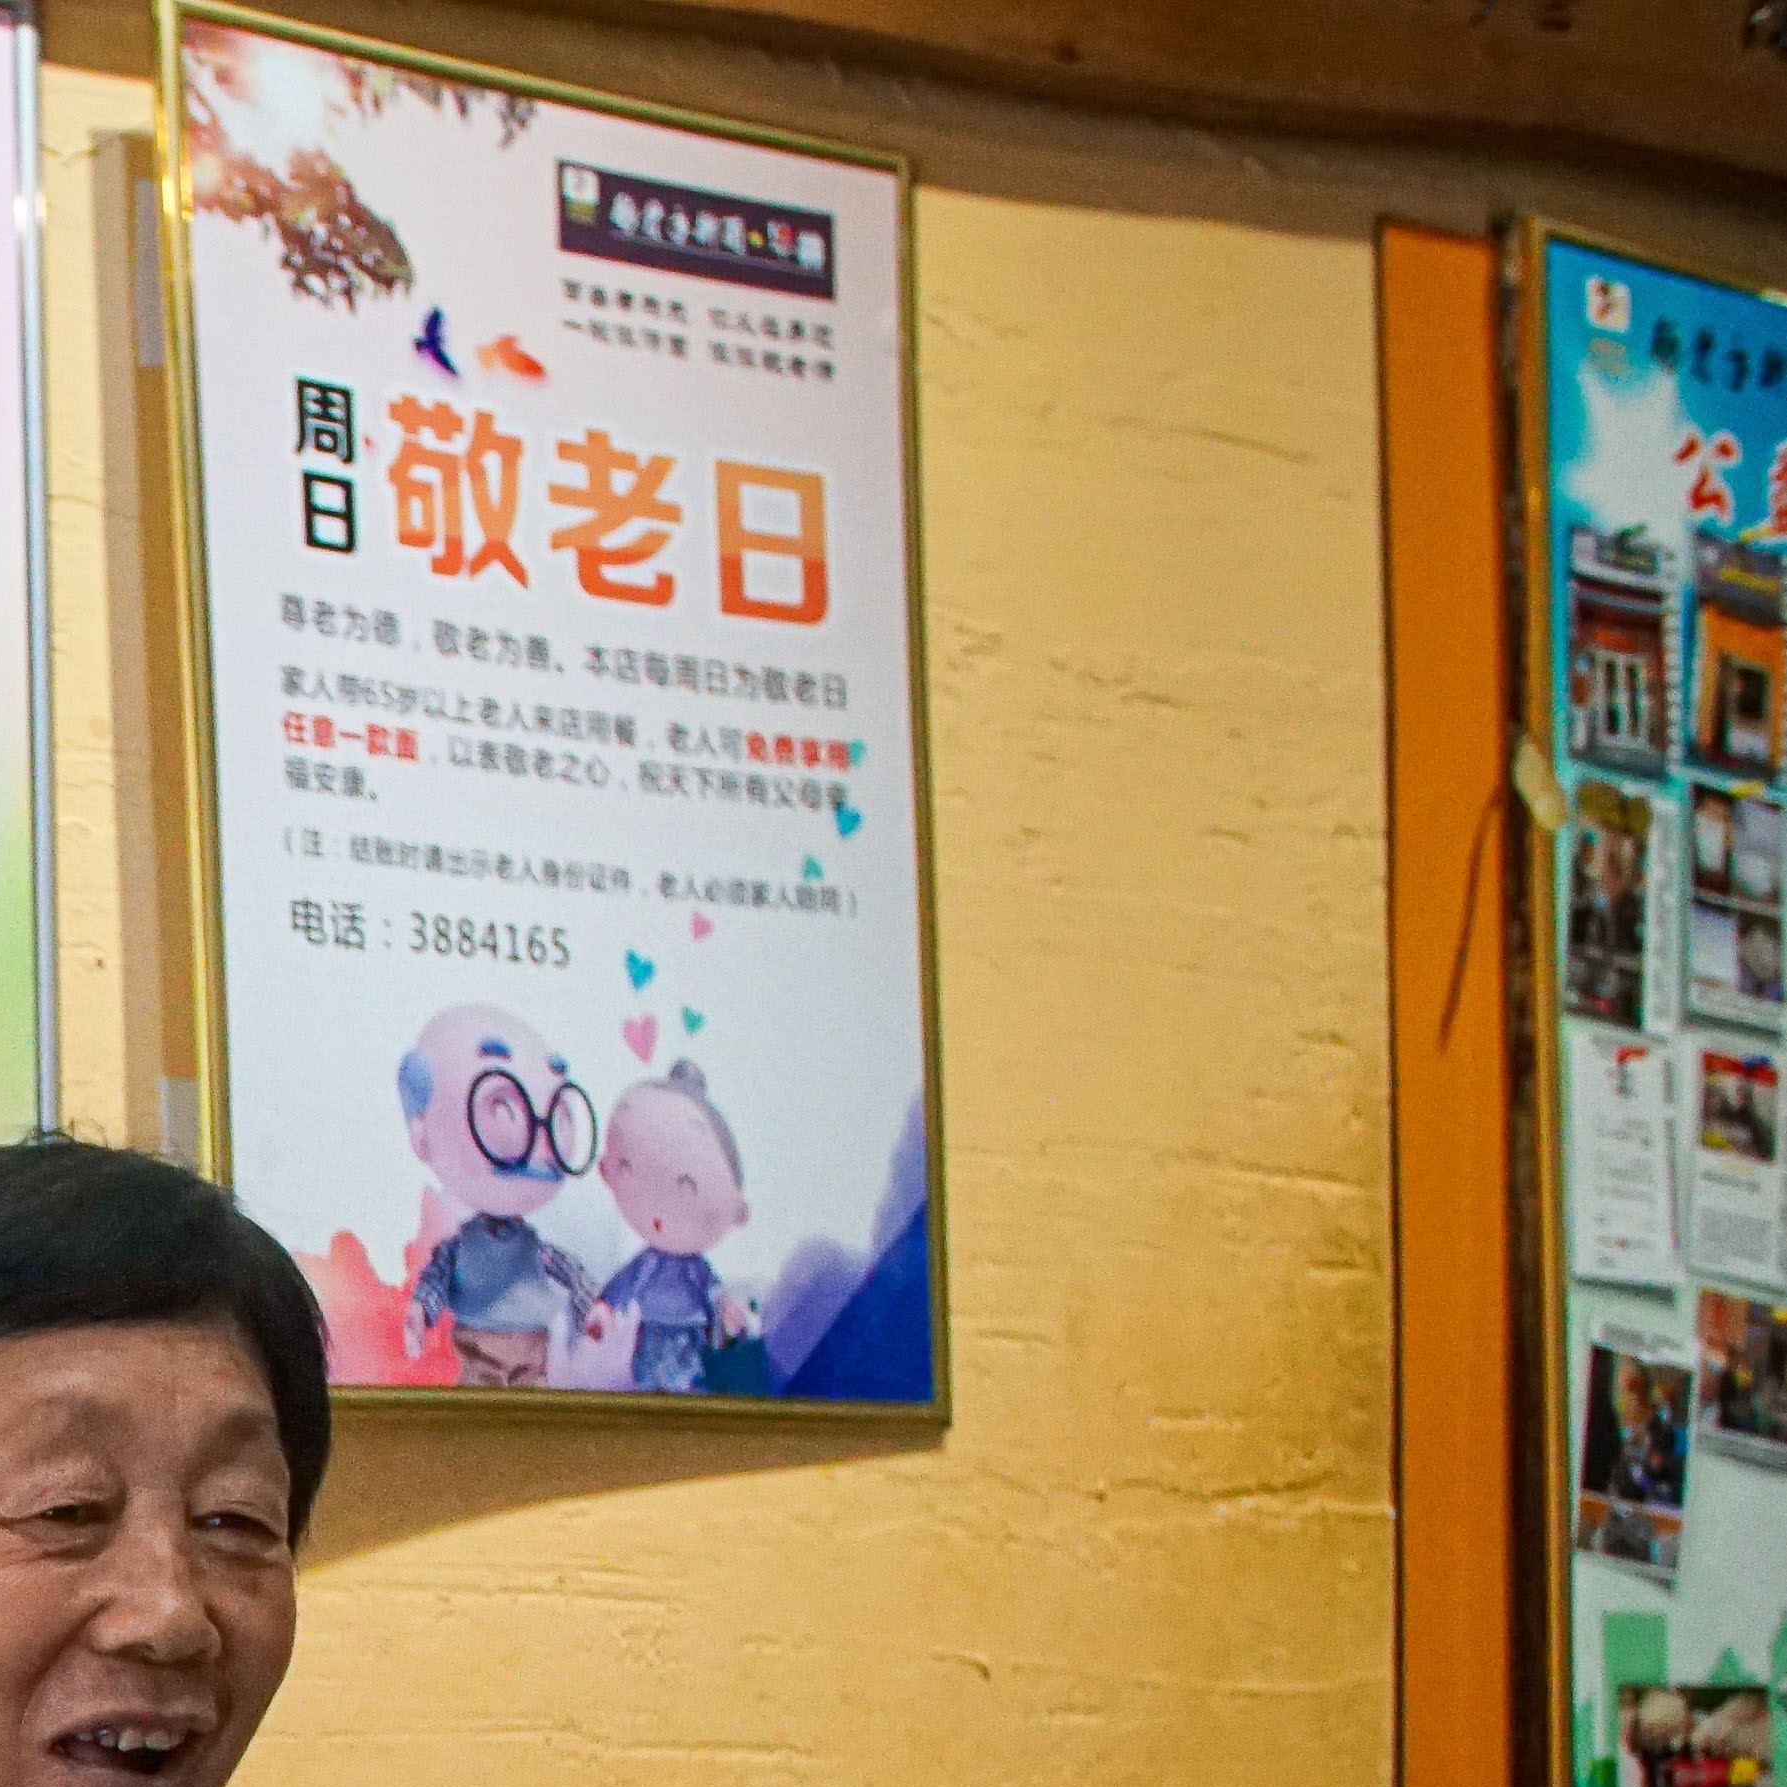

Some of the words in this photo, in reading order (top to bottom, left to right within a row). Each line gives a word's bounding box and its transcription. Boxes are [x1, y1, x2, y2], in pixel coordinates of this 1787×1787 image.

[294, 376, 358, 554] 周日
[386, 393, 831, 627] 敬老日
